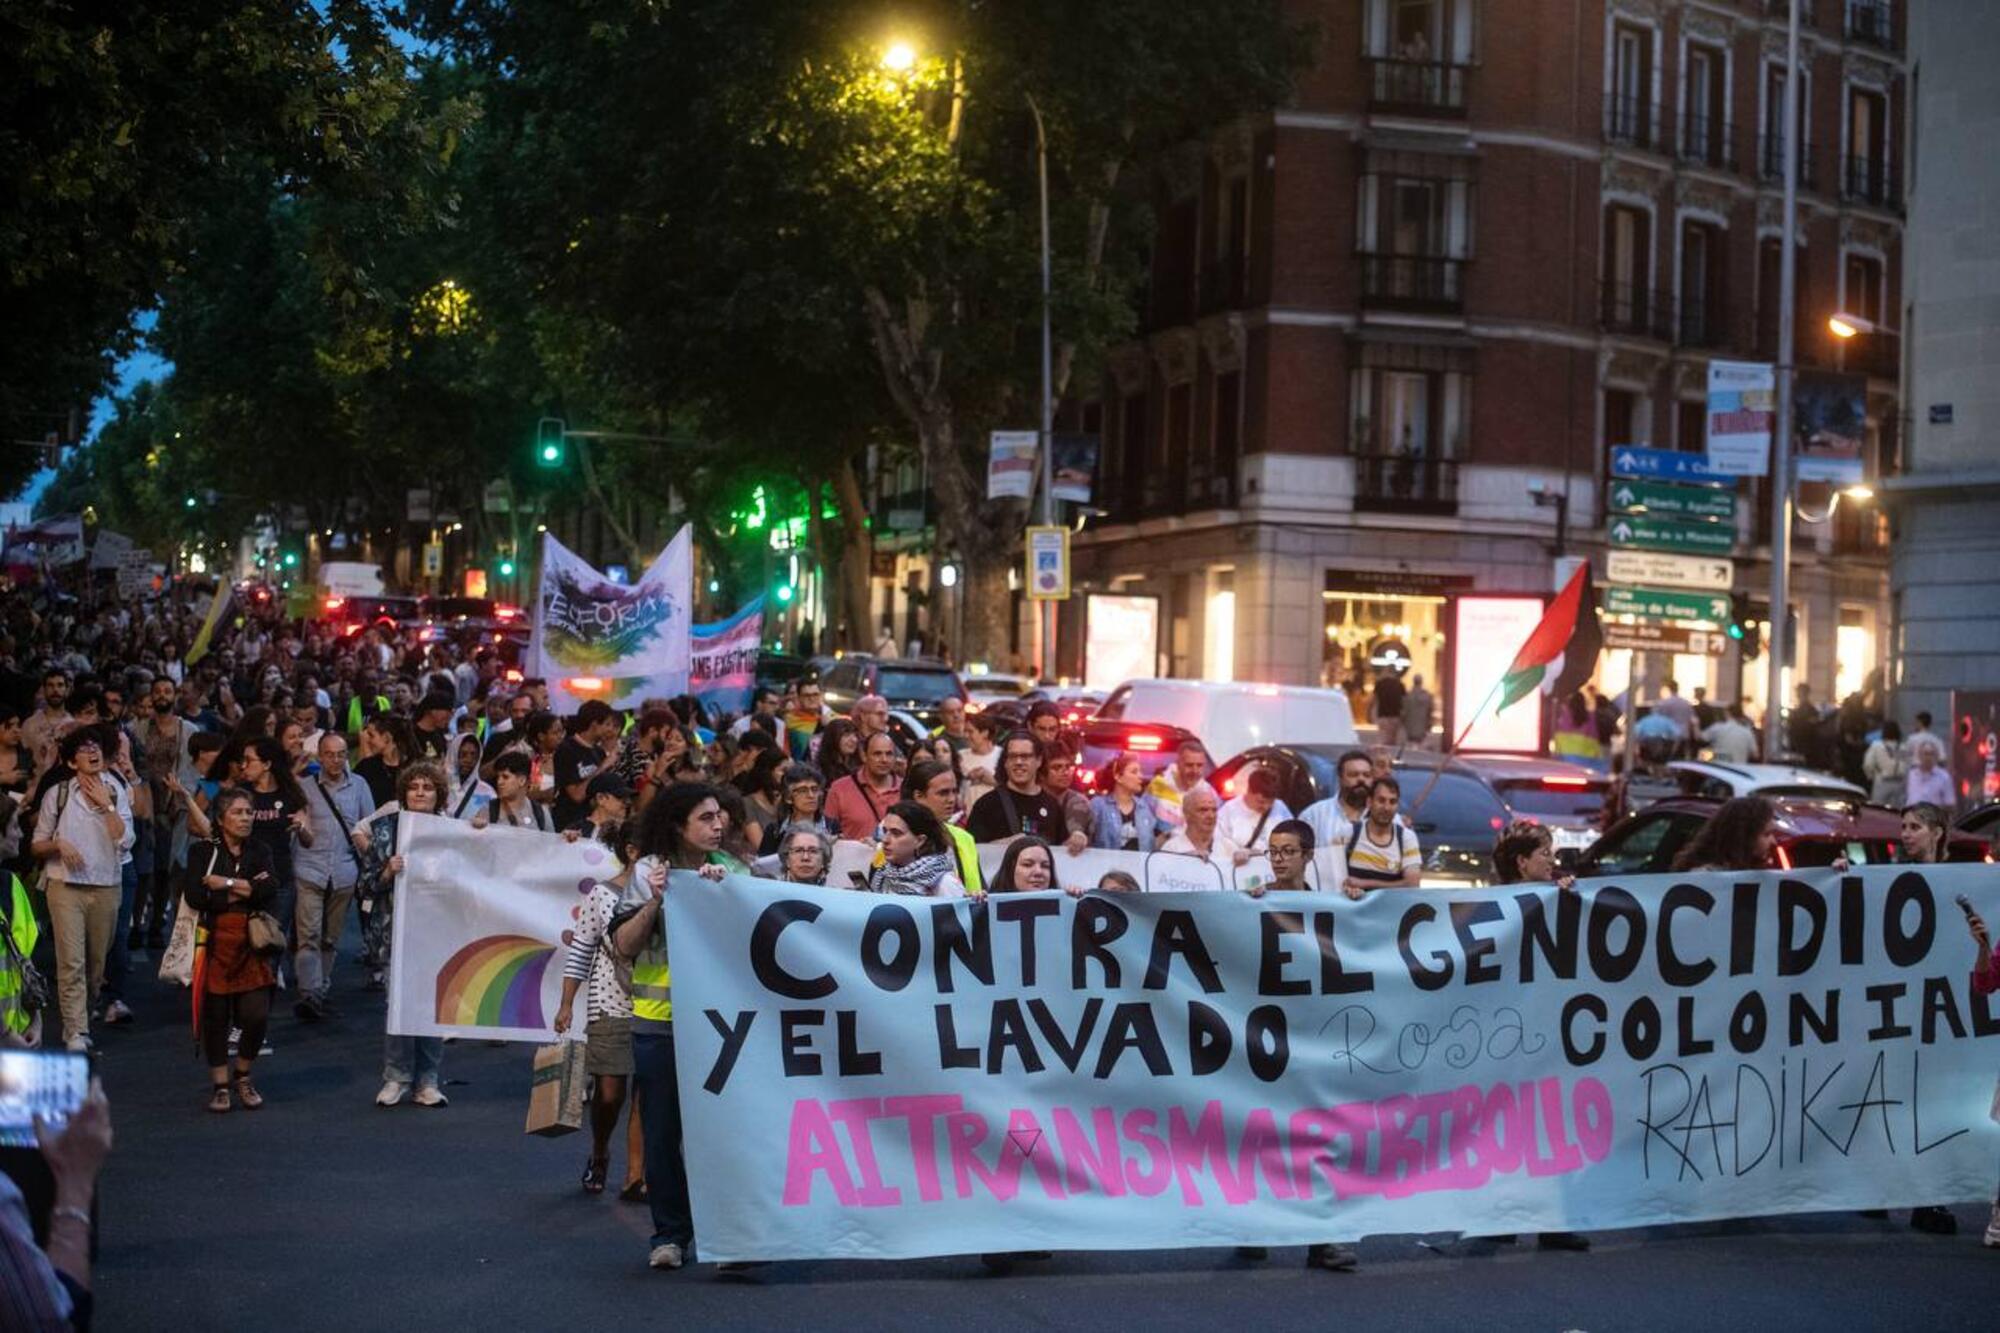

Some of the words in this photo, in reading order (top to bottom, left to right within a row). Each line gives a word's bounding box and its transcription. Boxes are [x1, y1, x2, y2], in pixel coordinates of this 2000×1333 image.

[750, 896, 1226, 1000] CONTRA
[1257, 910, 1375, 997] EL
[1397, 871, 1936, 991] GENOCIDIO
[702, 1008, 758, 1097] Y
[780, 1008, 884, 1078] EL
[934, 997, 1291, 1083] LAVADO
[1318, 1005, 1547, 1075] Rosa
[1560, 972, 2000, 1068] COLONIAL
